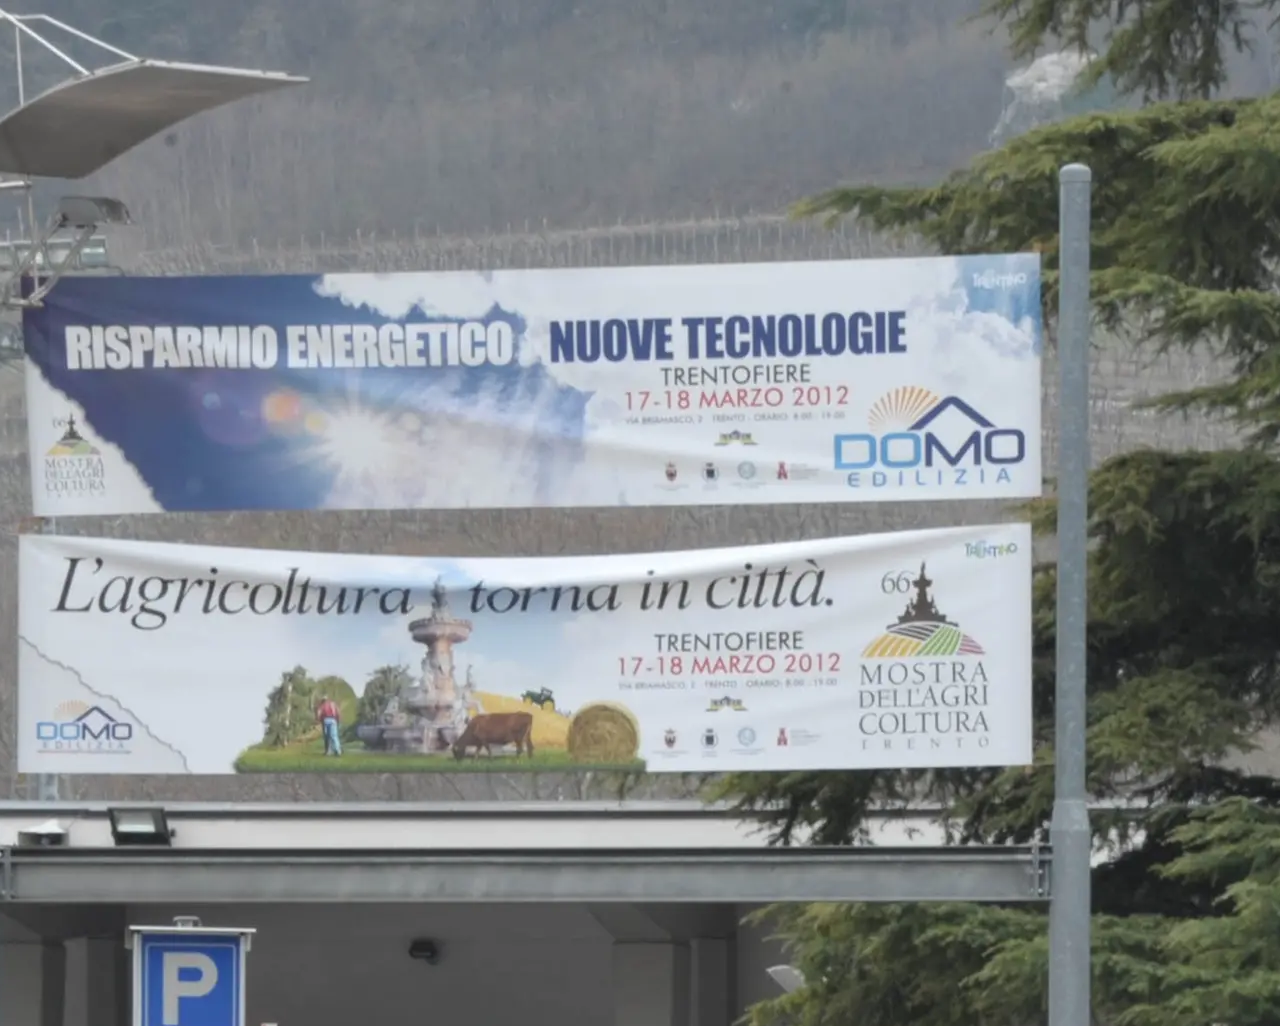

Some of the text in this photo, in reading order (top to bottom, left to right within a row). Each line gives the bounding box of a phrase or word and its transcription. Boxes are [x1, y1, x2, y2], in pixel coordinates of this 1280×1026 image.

[65, 321, 513, 370] RISPARMIO ENERGETICO
[550, 311, 907, 363] NUOVE TECNOLOGIE
[661, 364, 811, 386] TRENTOFIERE
[625, 386, 849, 411] 17-18 MARZO 2012
[834, 428, 1026, 470] DOMO
[847, 468, 1011, 488] EDILIZIA
[50, 557, 834, 630] L'agricoltura torna in città.
[654, 631, 804, 652] TRENTOFIERE
[619, 653, 840, 676] 17-18 MARZO 2012
[860, 661, 988, 686] MOSTRA
[859, 684, 988, 709] DELL'AGRI
[37, 722, 132, 740] DOMO
[859, 710, 989, 735] COLTURA
[862, 735, 989, 750] TRENTO
[162, 952, 219, 1026] P
